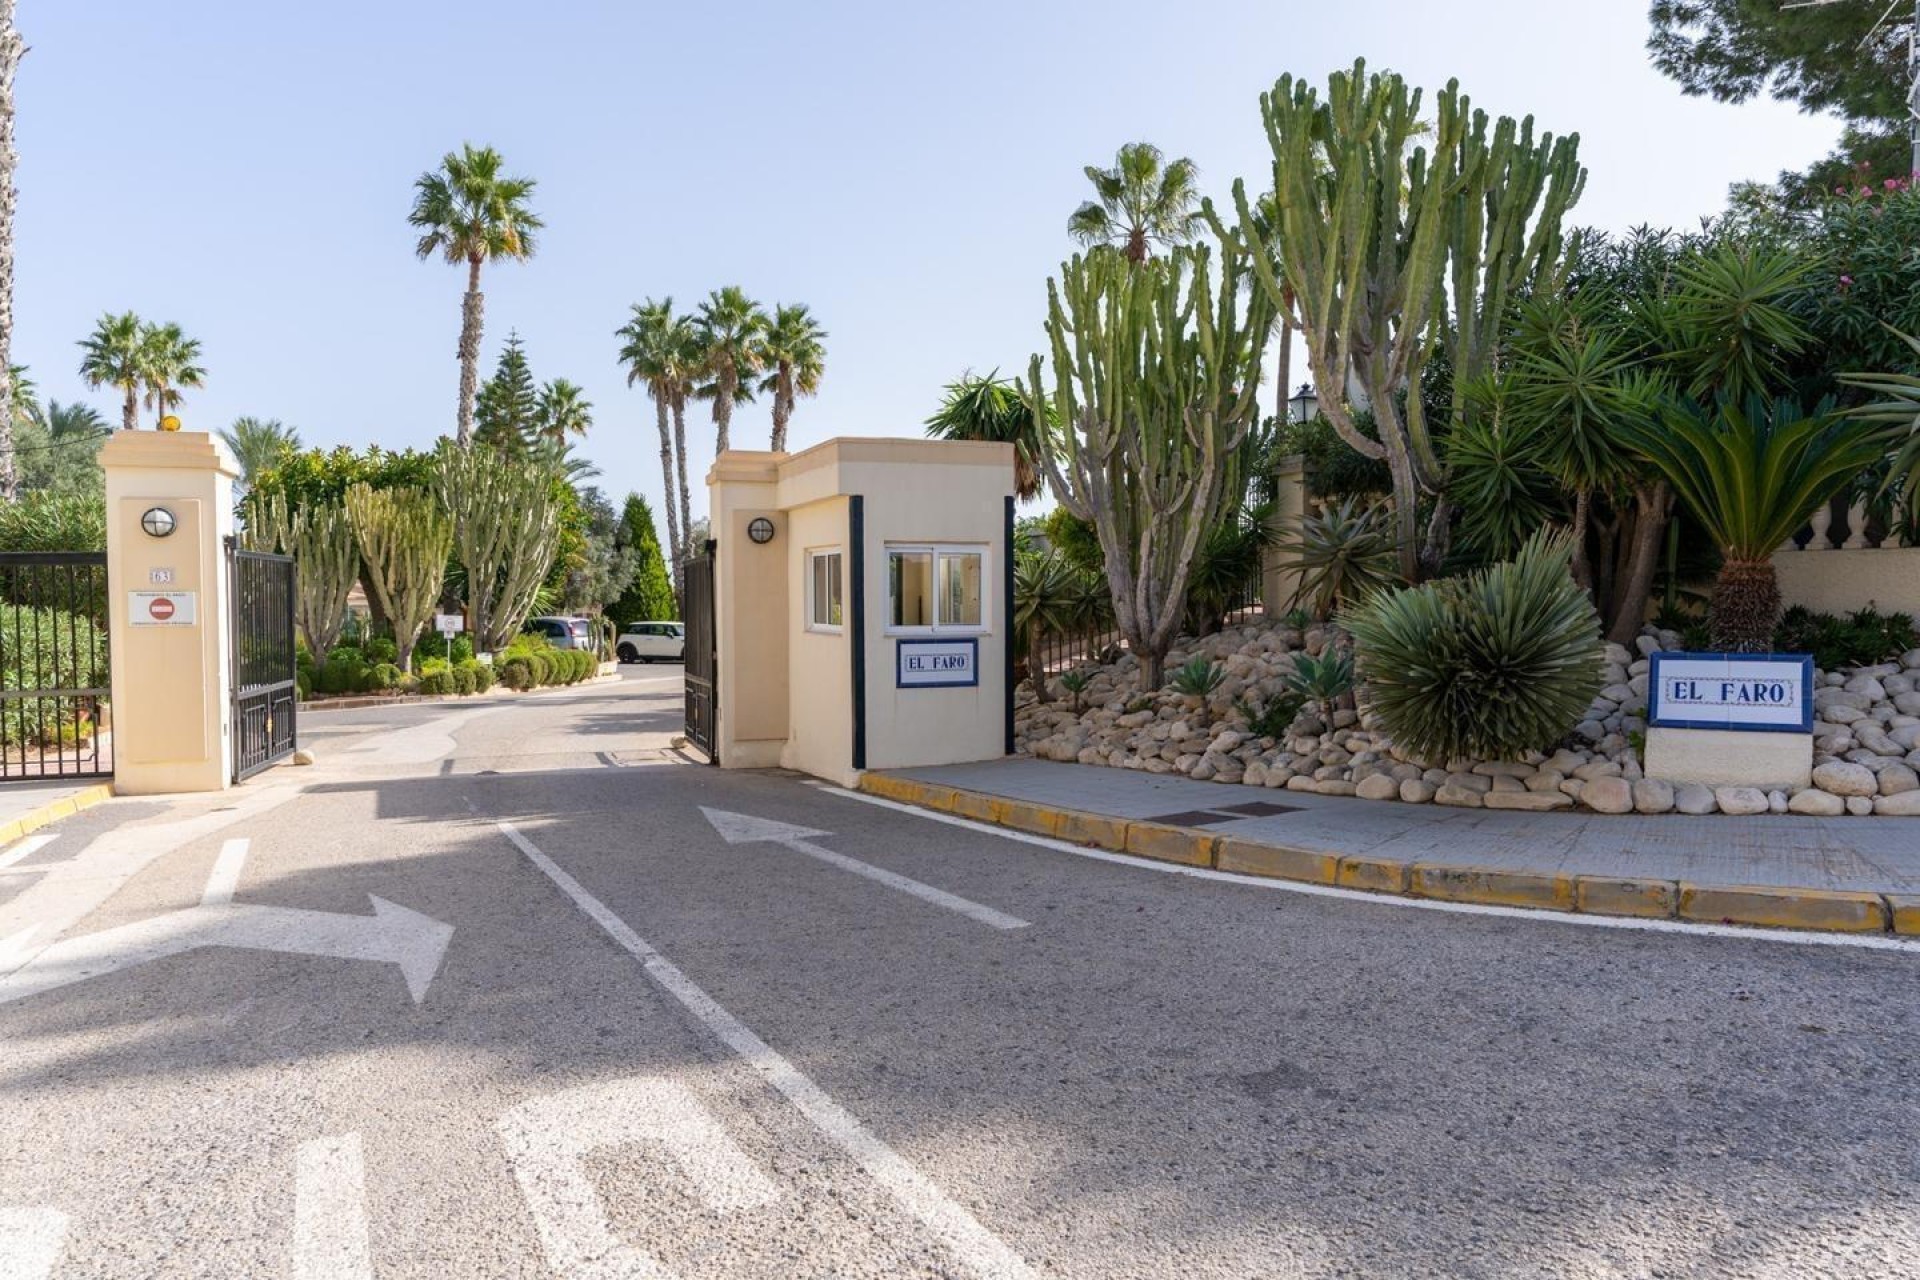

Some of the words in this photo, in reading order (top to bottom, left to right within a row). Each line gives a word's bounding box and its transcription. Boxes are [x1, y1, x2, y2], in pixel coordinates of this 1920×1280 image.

[909, 656, 924, 669] EL
[932, 655, 965, 669] FARO
[1674, 681, 1703, 700] EL
[1720, 682, 1785, 703] FARO
